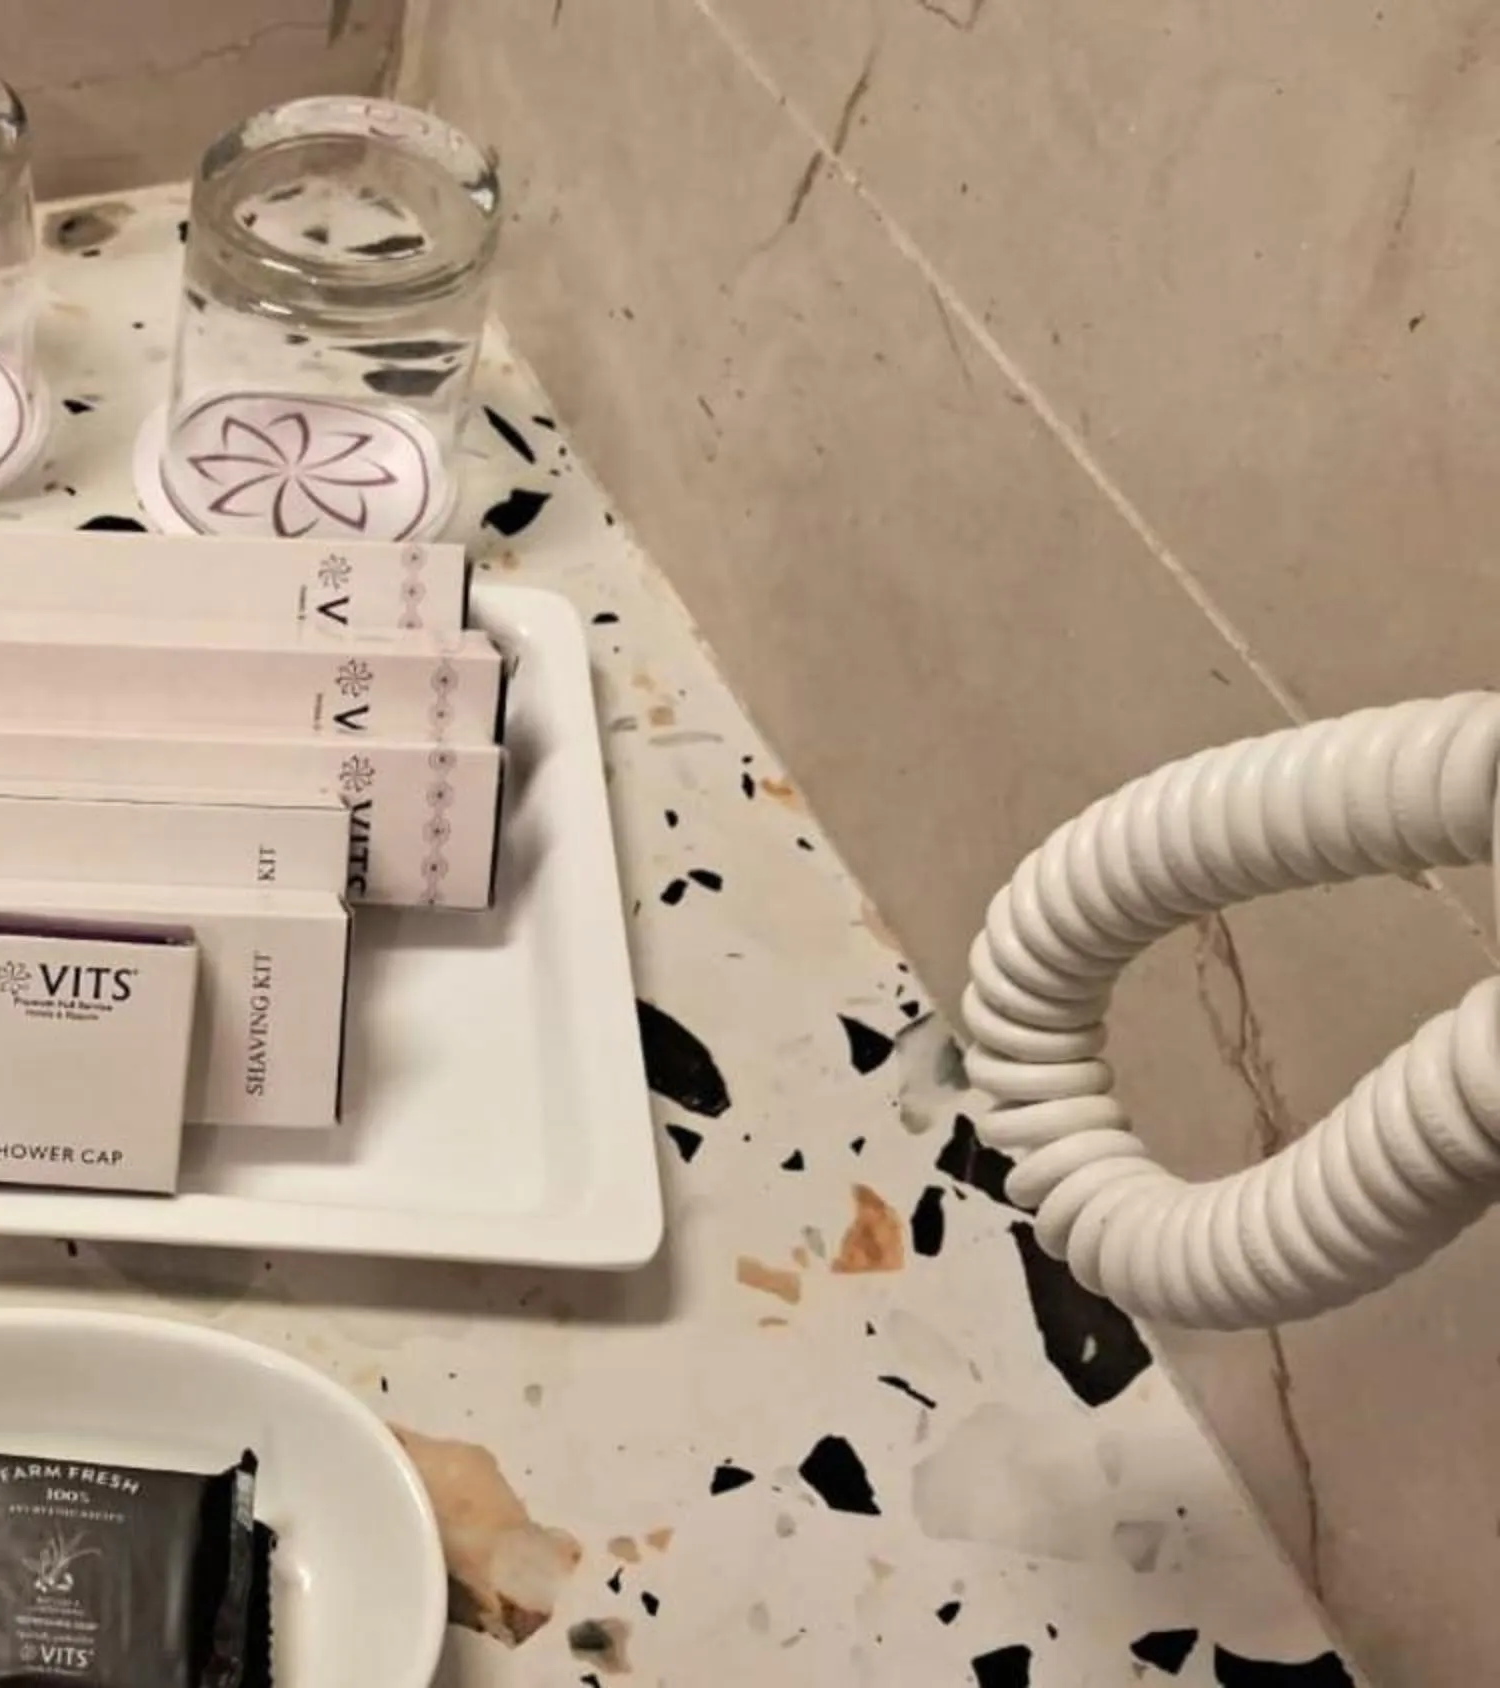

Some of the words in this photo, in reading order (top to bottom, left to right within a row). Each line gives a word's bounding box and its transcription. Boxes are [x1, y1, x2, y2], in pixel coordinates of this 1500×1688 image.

[257, 844, 276, 882] KIT
[38, 962, 132, 1001] VITS
[251, 950, 273, 990] KIT
[245, 996, 271, 1097] SHAVING
[81, 1148, 123, 1166] CAP
[0, 1464, 62, 1484] FARM
[68, 1466, 140, 1495] FRESH
[41, 1643, 89, 1669] VITS
